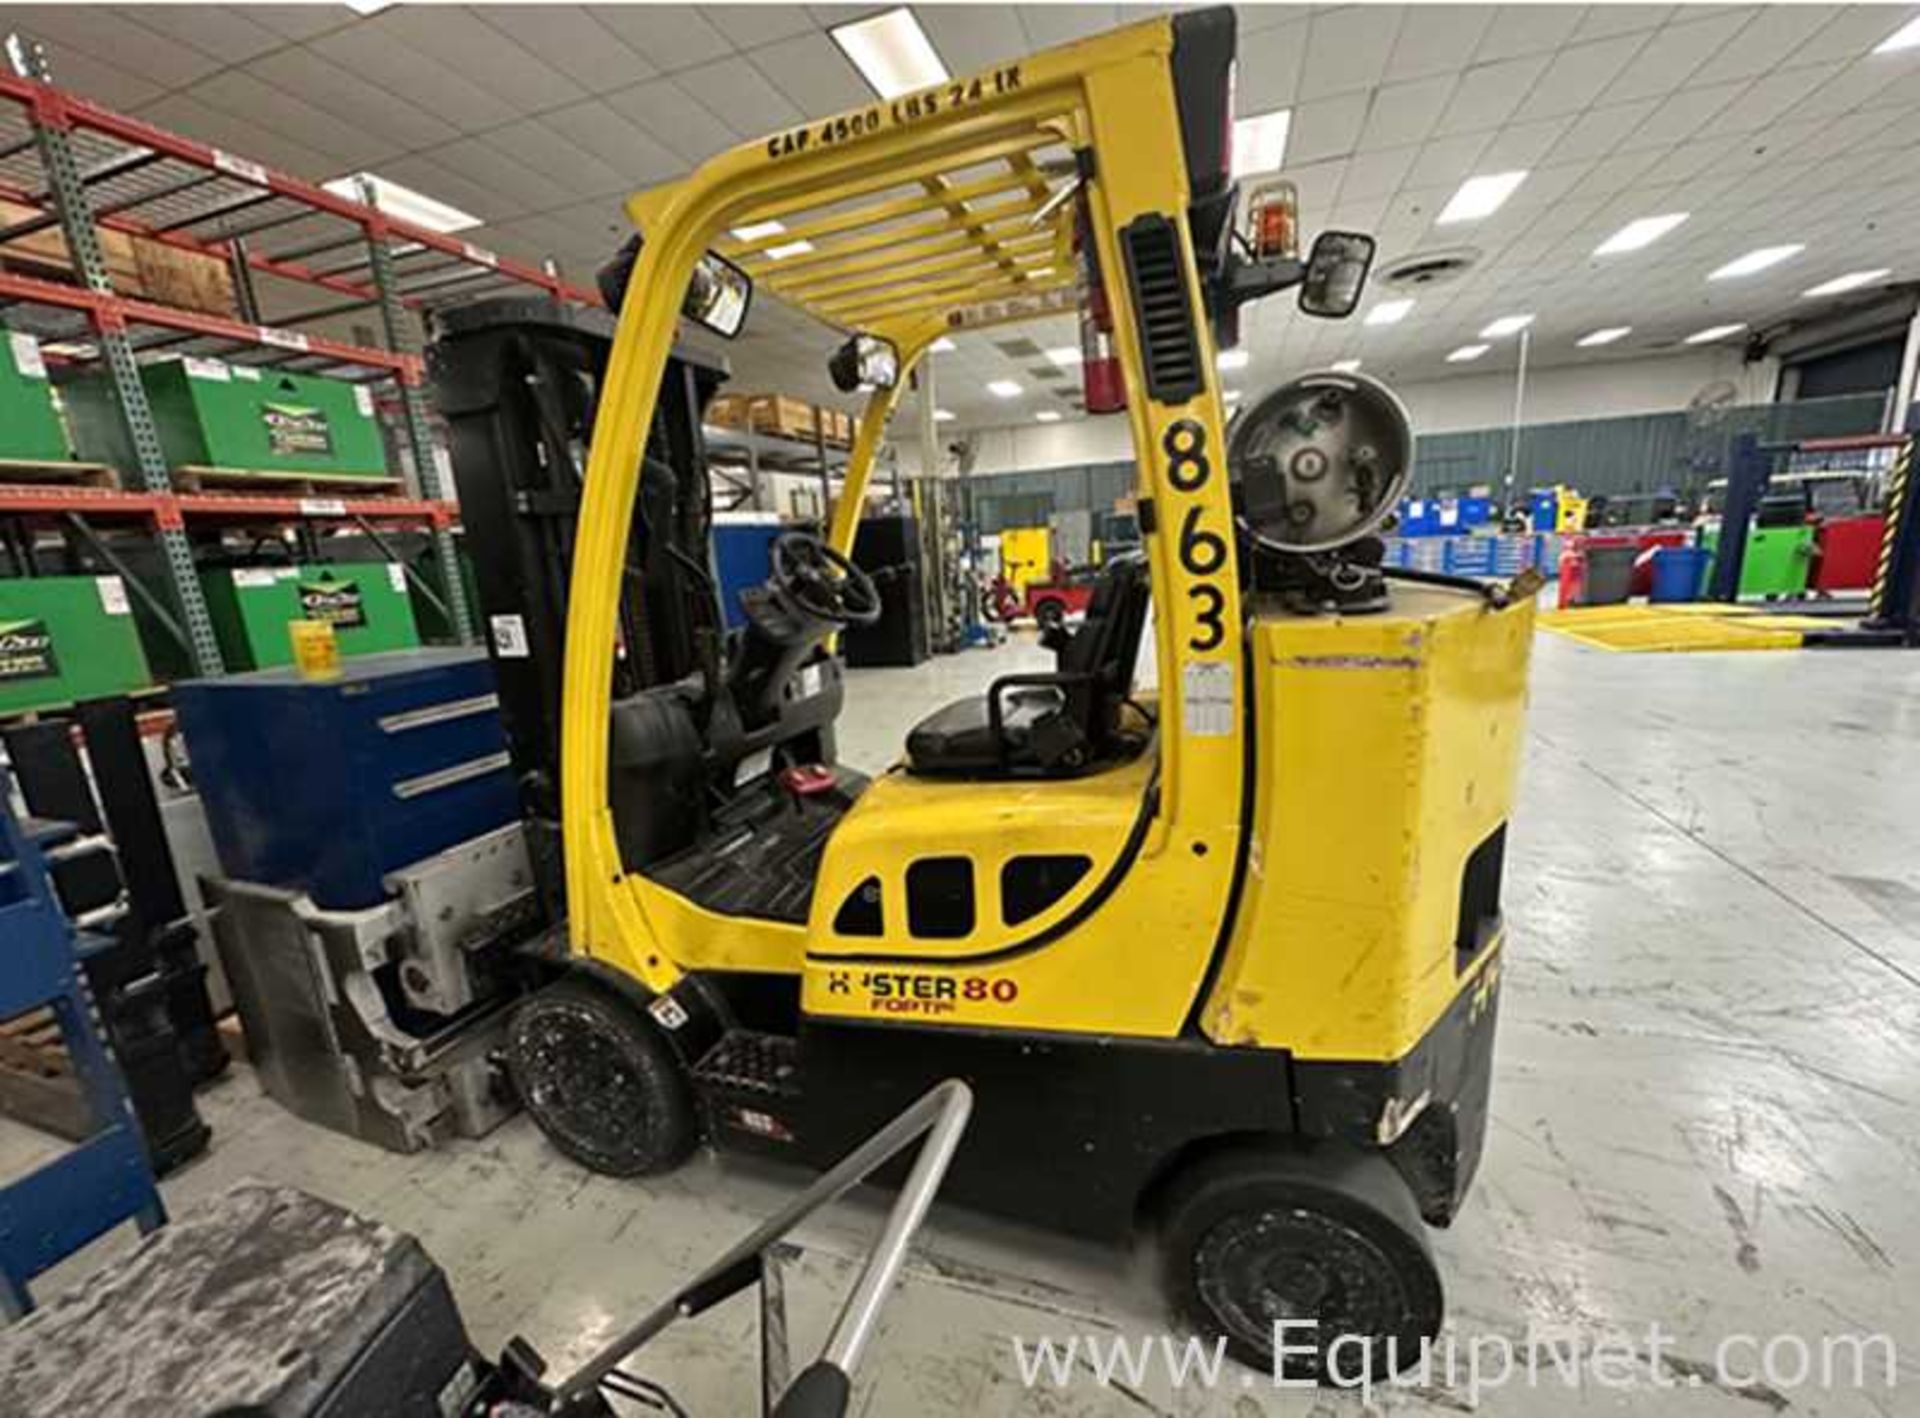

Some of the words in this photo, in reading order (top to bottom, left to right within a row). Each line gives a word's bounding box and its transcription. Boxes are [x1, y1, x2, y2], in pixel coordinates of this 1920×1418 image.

[949, 78, 982, 107] 24
[1163, 418, 1228, 652] 863
[962, 977, 1019, 1004] 80
